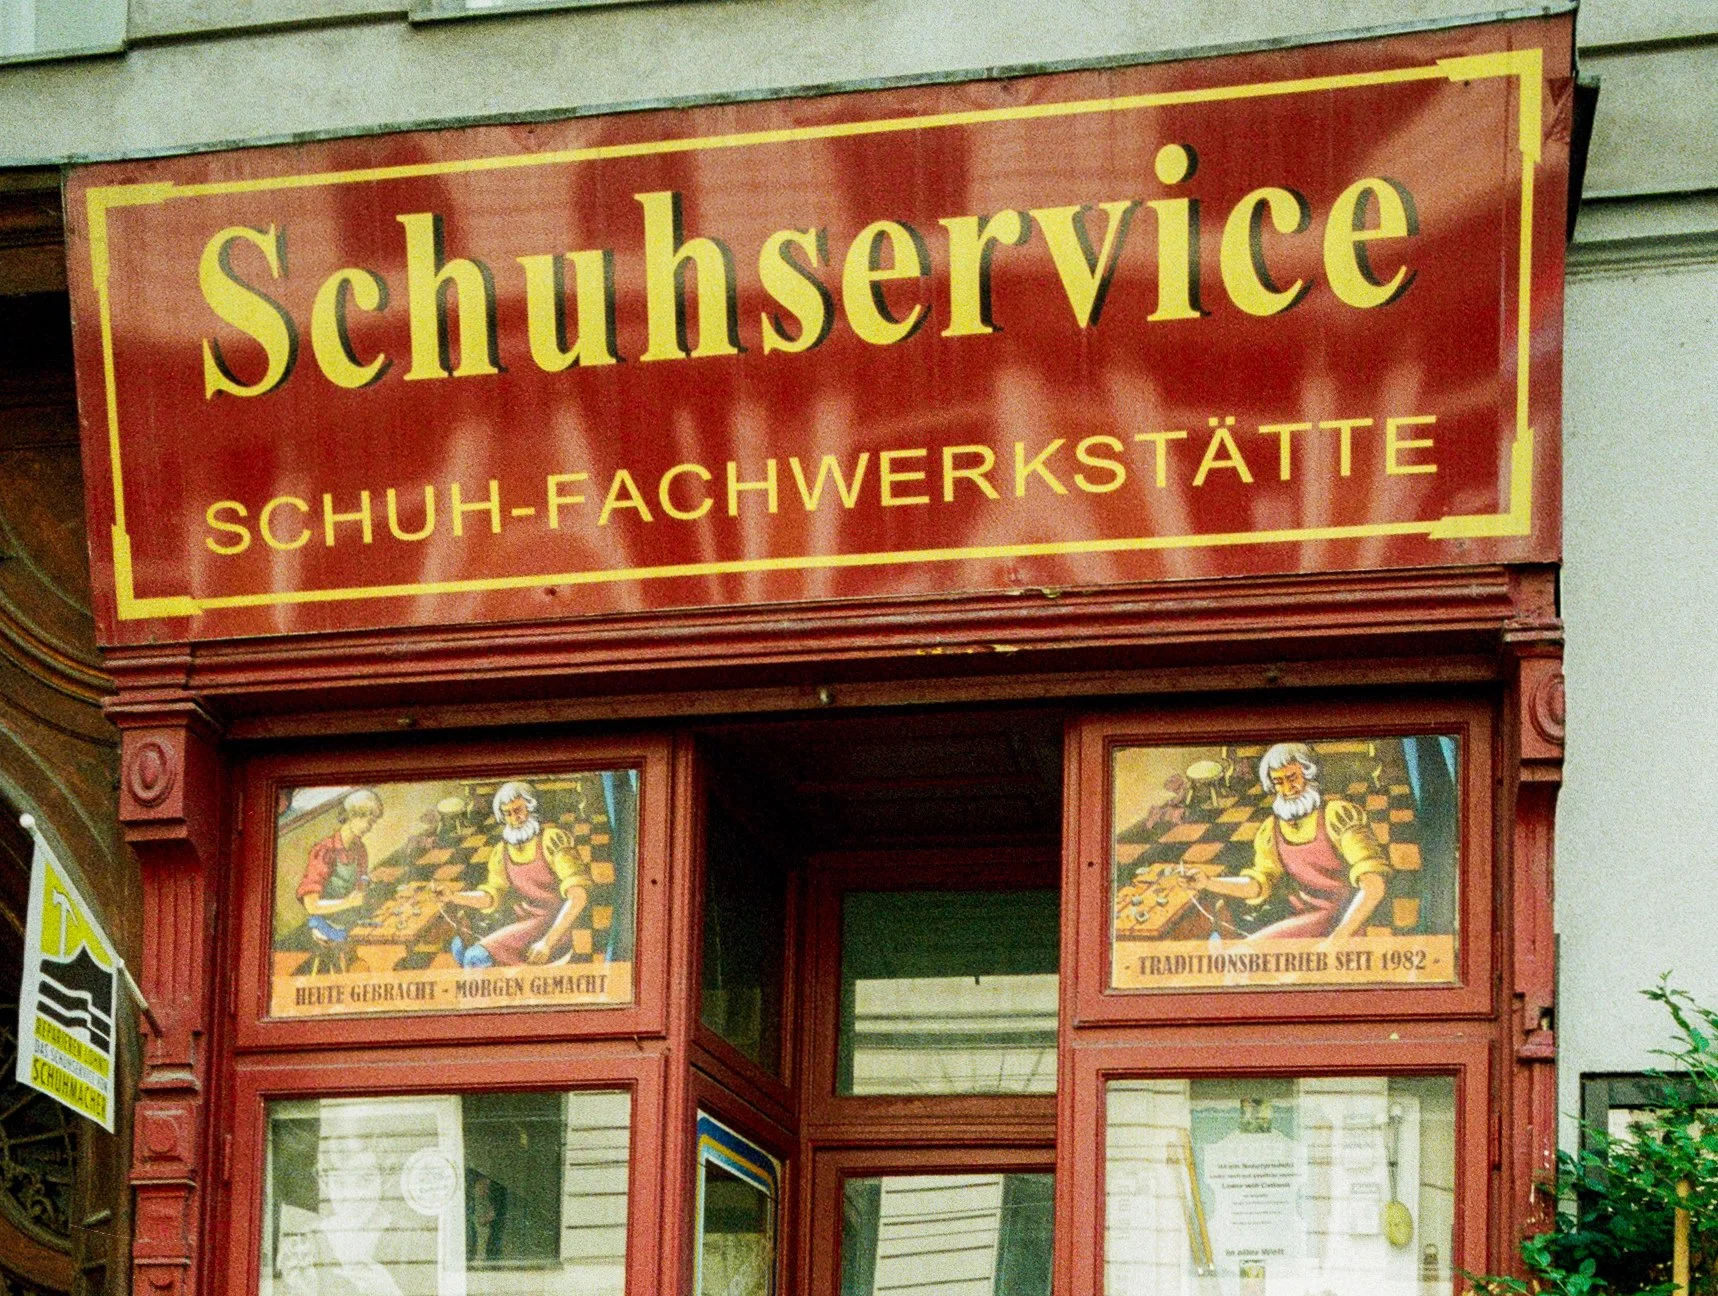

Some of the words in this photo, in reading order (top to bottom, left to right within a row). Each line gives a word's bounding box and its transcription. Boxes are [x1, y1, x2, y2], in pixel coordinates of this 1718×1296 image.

[198, 144, 1420, 400] Schuhservice
[204, 415, 1439, 555] SCHUH-FACHWERKSTÄTTE
[295, 986, 345, 1007] HEUTE
[350, 982, 437, 1003] GEBRACHT
[455, 978, 525, 999] MORGEN
[530, 973, 608, 995] GEMACHT
[1138, 952, 1329, 976] TRADITIONSBETRIEB
[1335, 951, 1372, 972] SEIT
[1380, 950, 1426, 971] 1982
